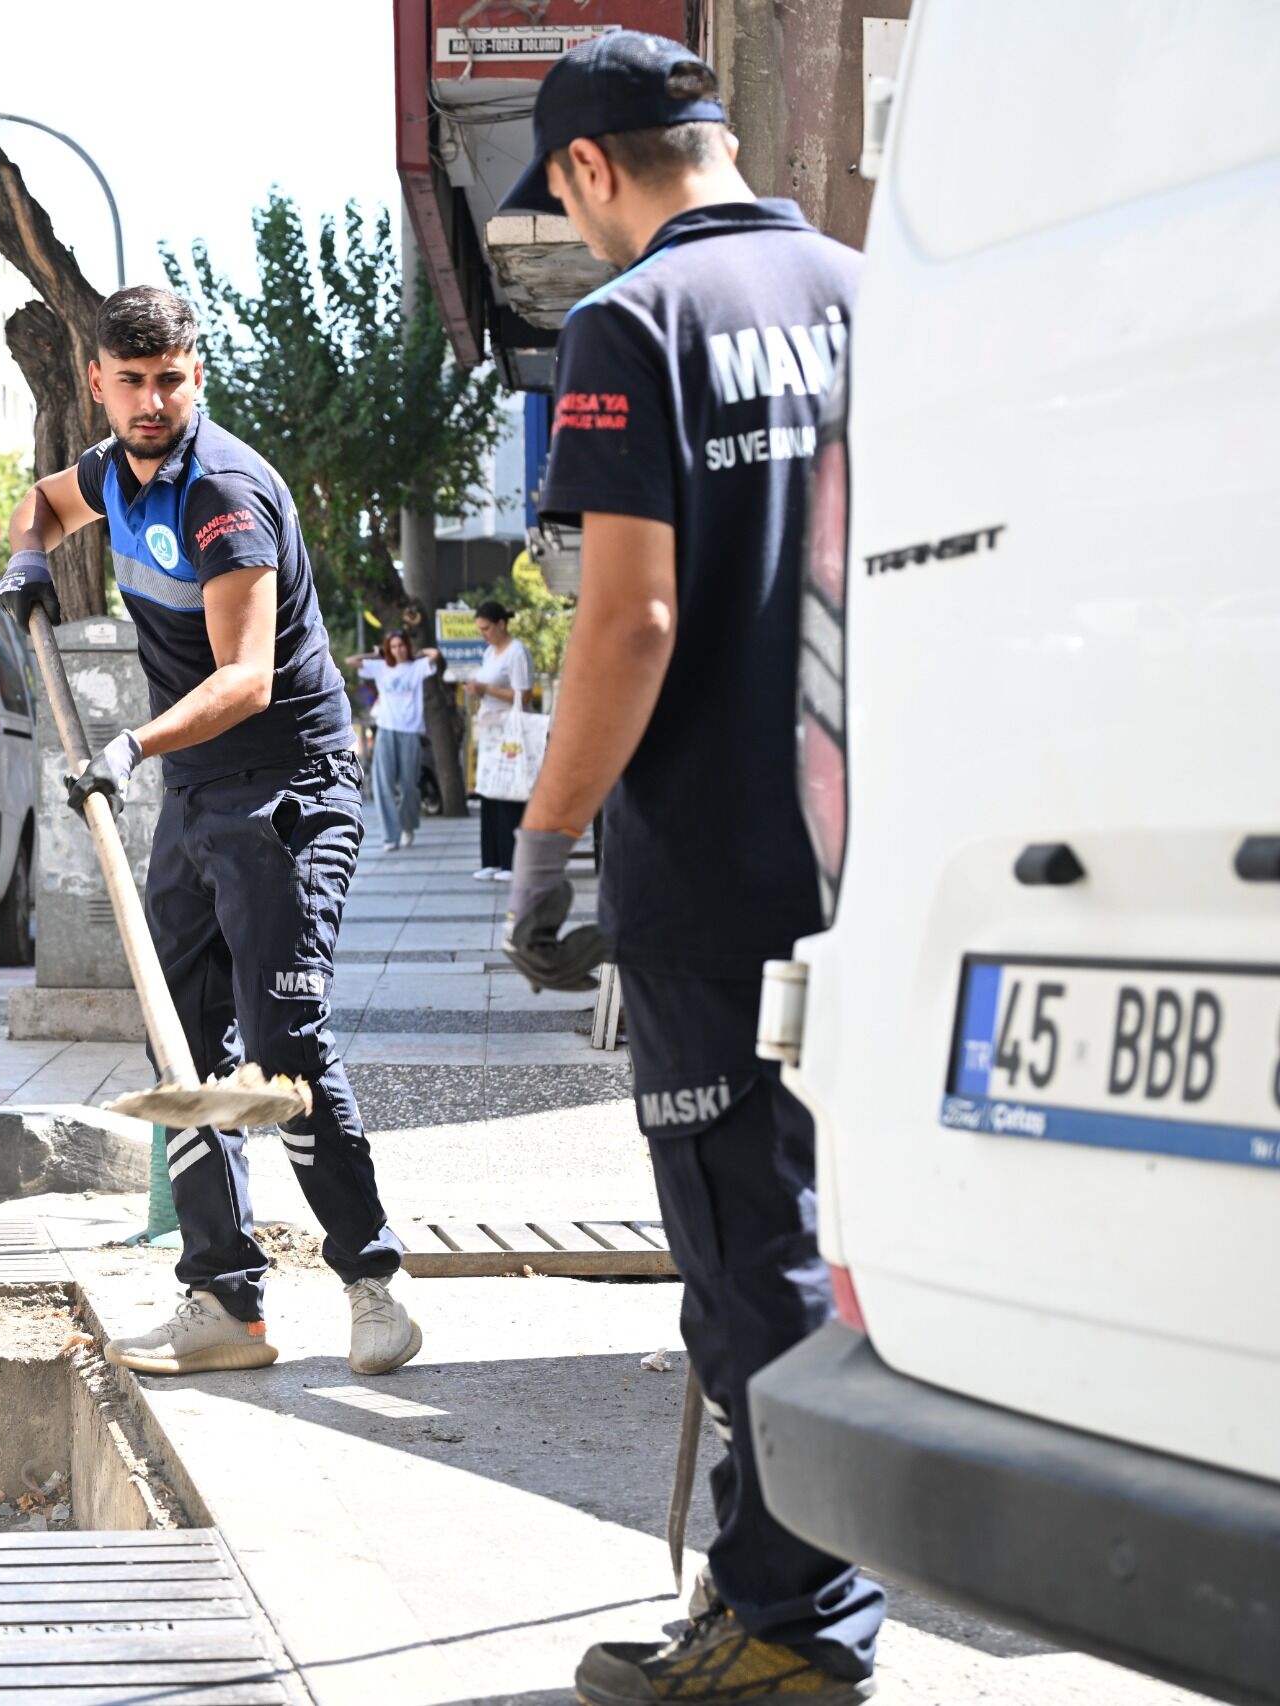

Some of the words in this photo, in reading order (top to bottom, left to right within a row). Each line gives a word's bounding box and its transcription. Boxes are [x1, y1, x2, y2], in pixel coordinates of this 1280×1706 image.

[522, 38, 561, 51] DOLUMU
[705, 438, 736, 471] SU
[737, 429, 770, 464] VE
[993, 980, 1066, 1089] 45
[1108, 986, 1222, 1104] BBB
[641, 1076, 731, 1128] MASKİ
